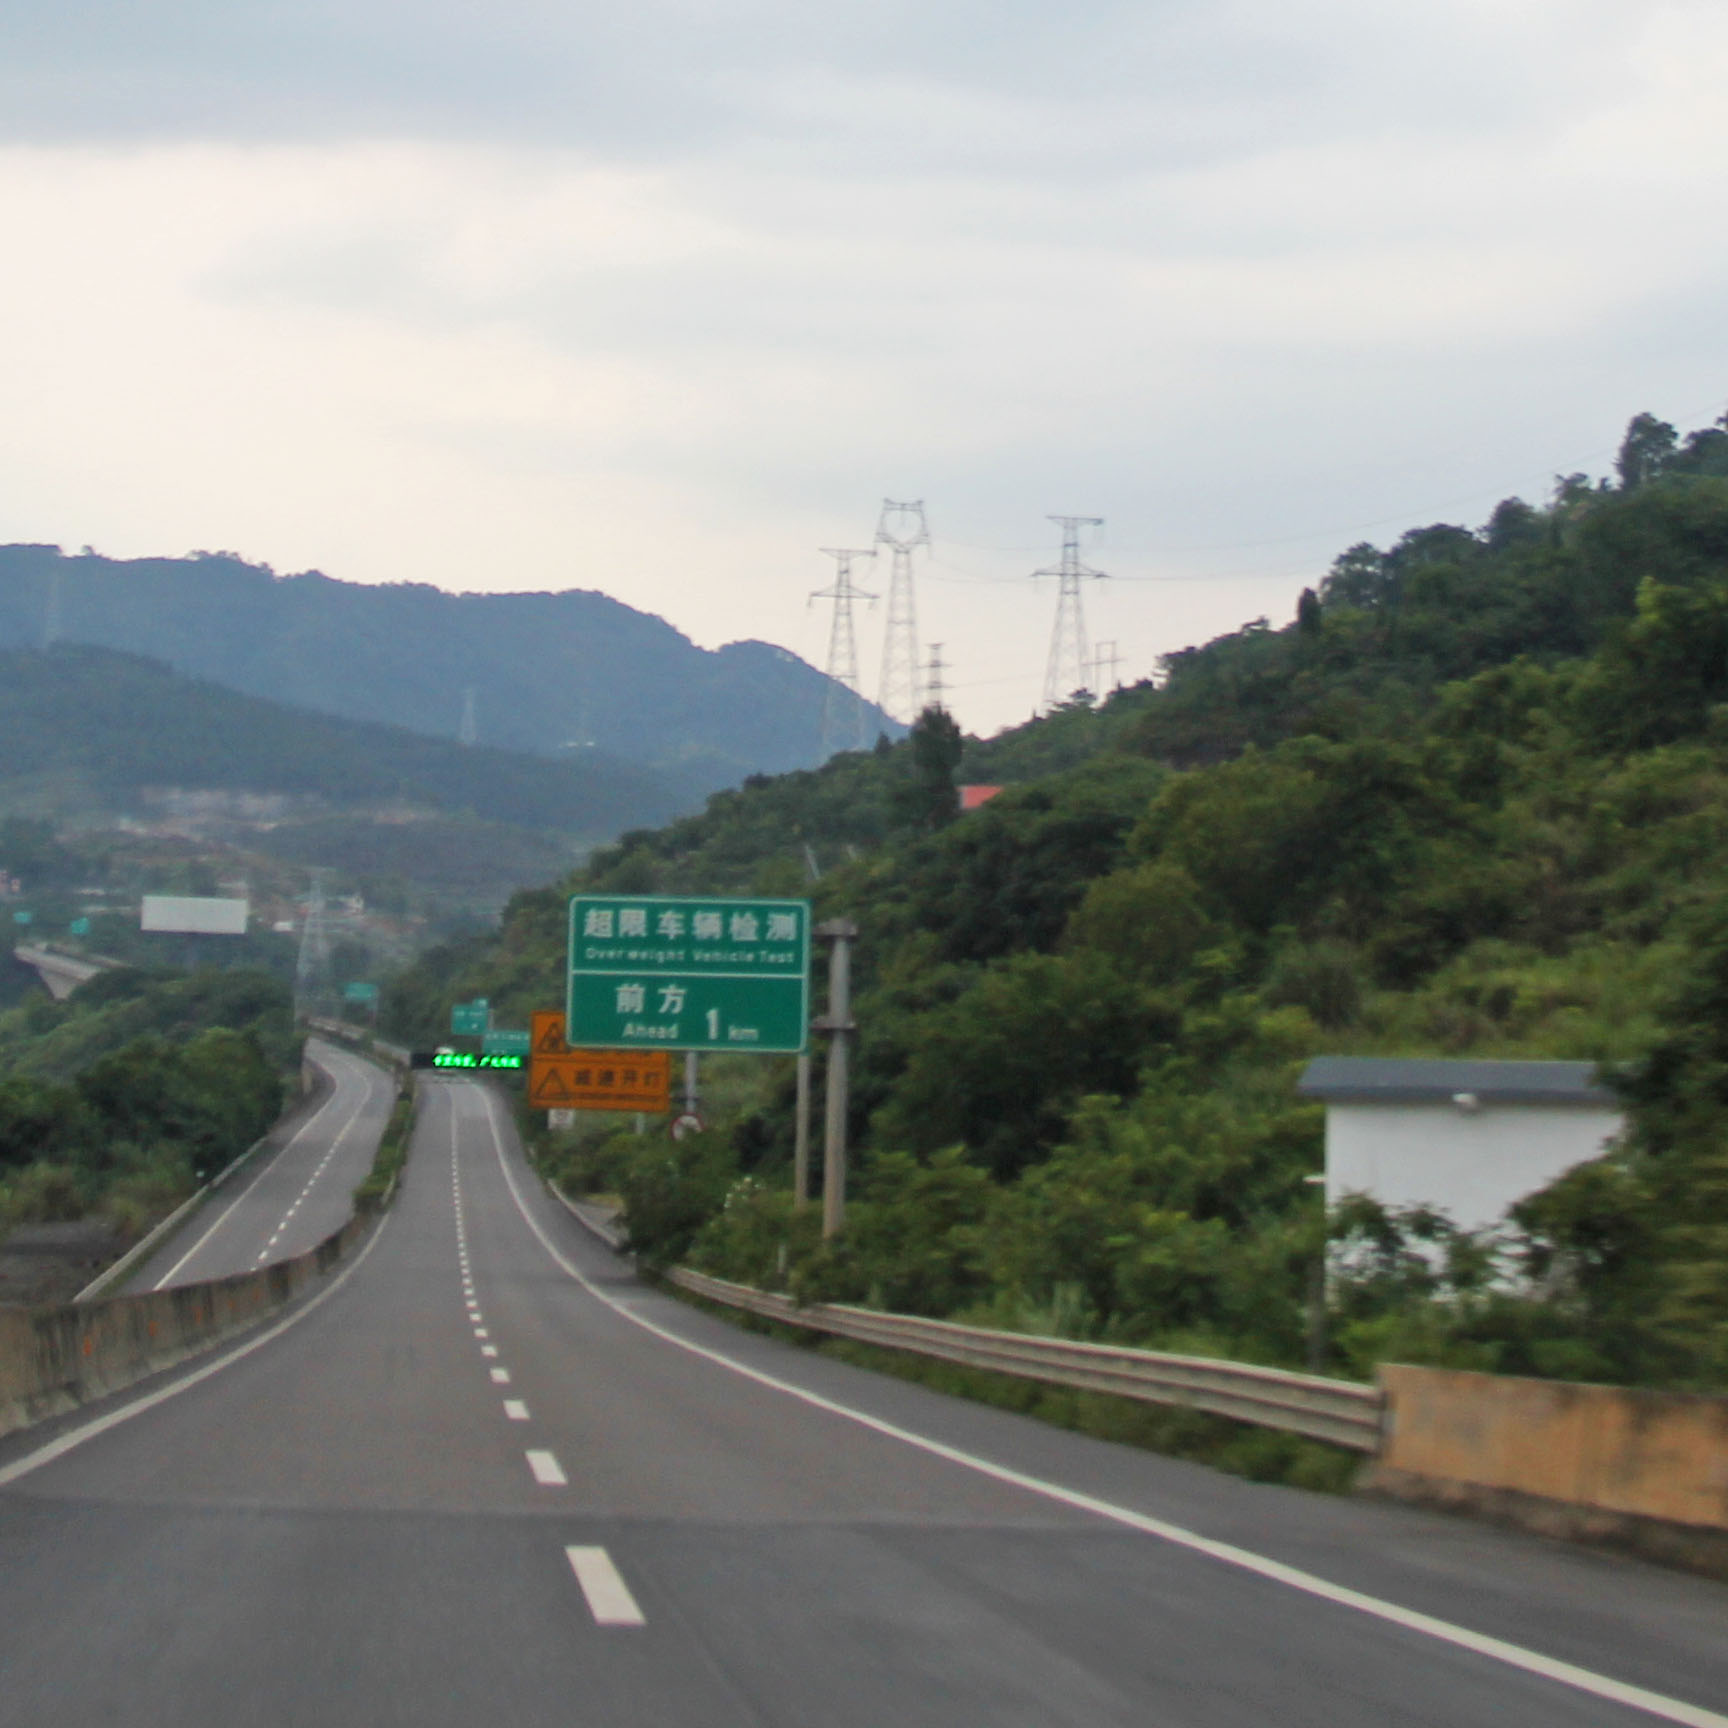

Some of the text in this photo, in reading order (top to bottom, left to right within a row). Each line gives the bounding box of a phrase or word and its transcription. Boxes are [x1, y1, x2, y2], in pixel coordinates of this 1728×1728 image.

[583, 908, 798, 942] 超限车辆检测
[615, 983, 687, 1015] 前方
[622, 1008, 760, 1041] Ahead 1 km
